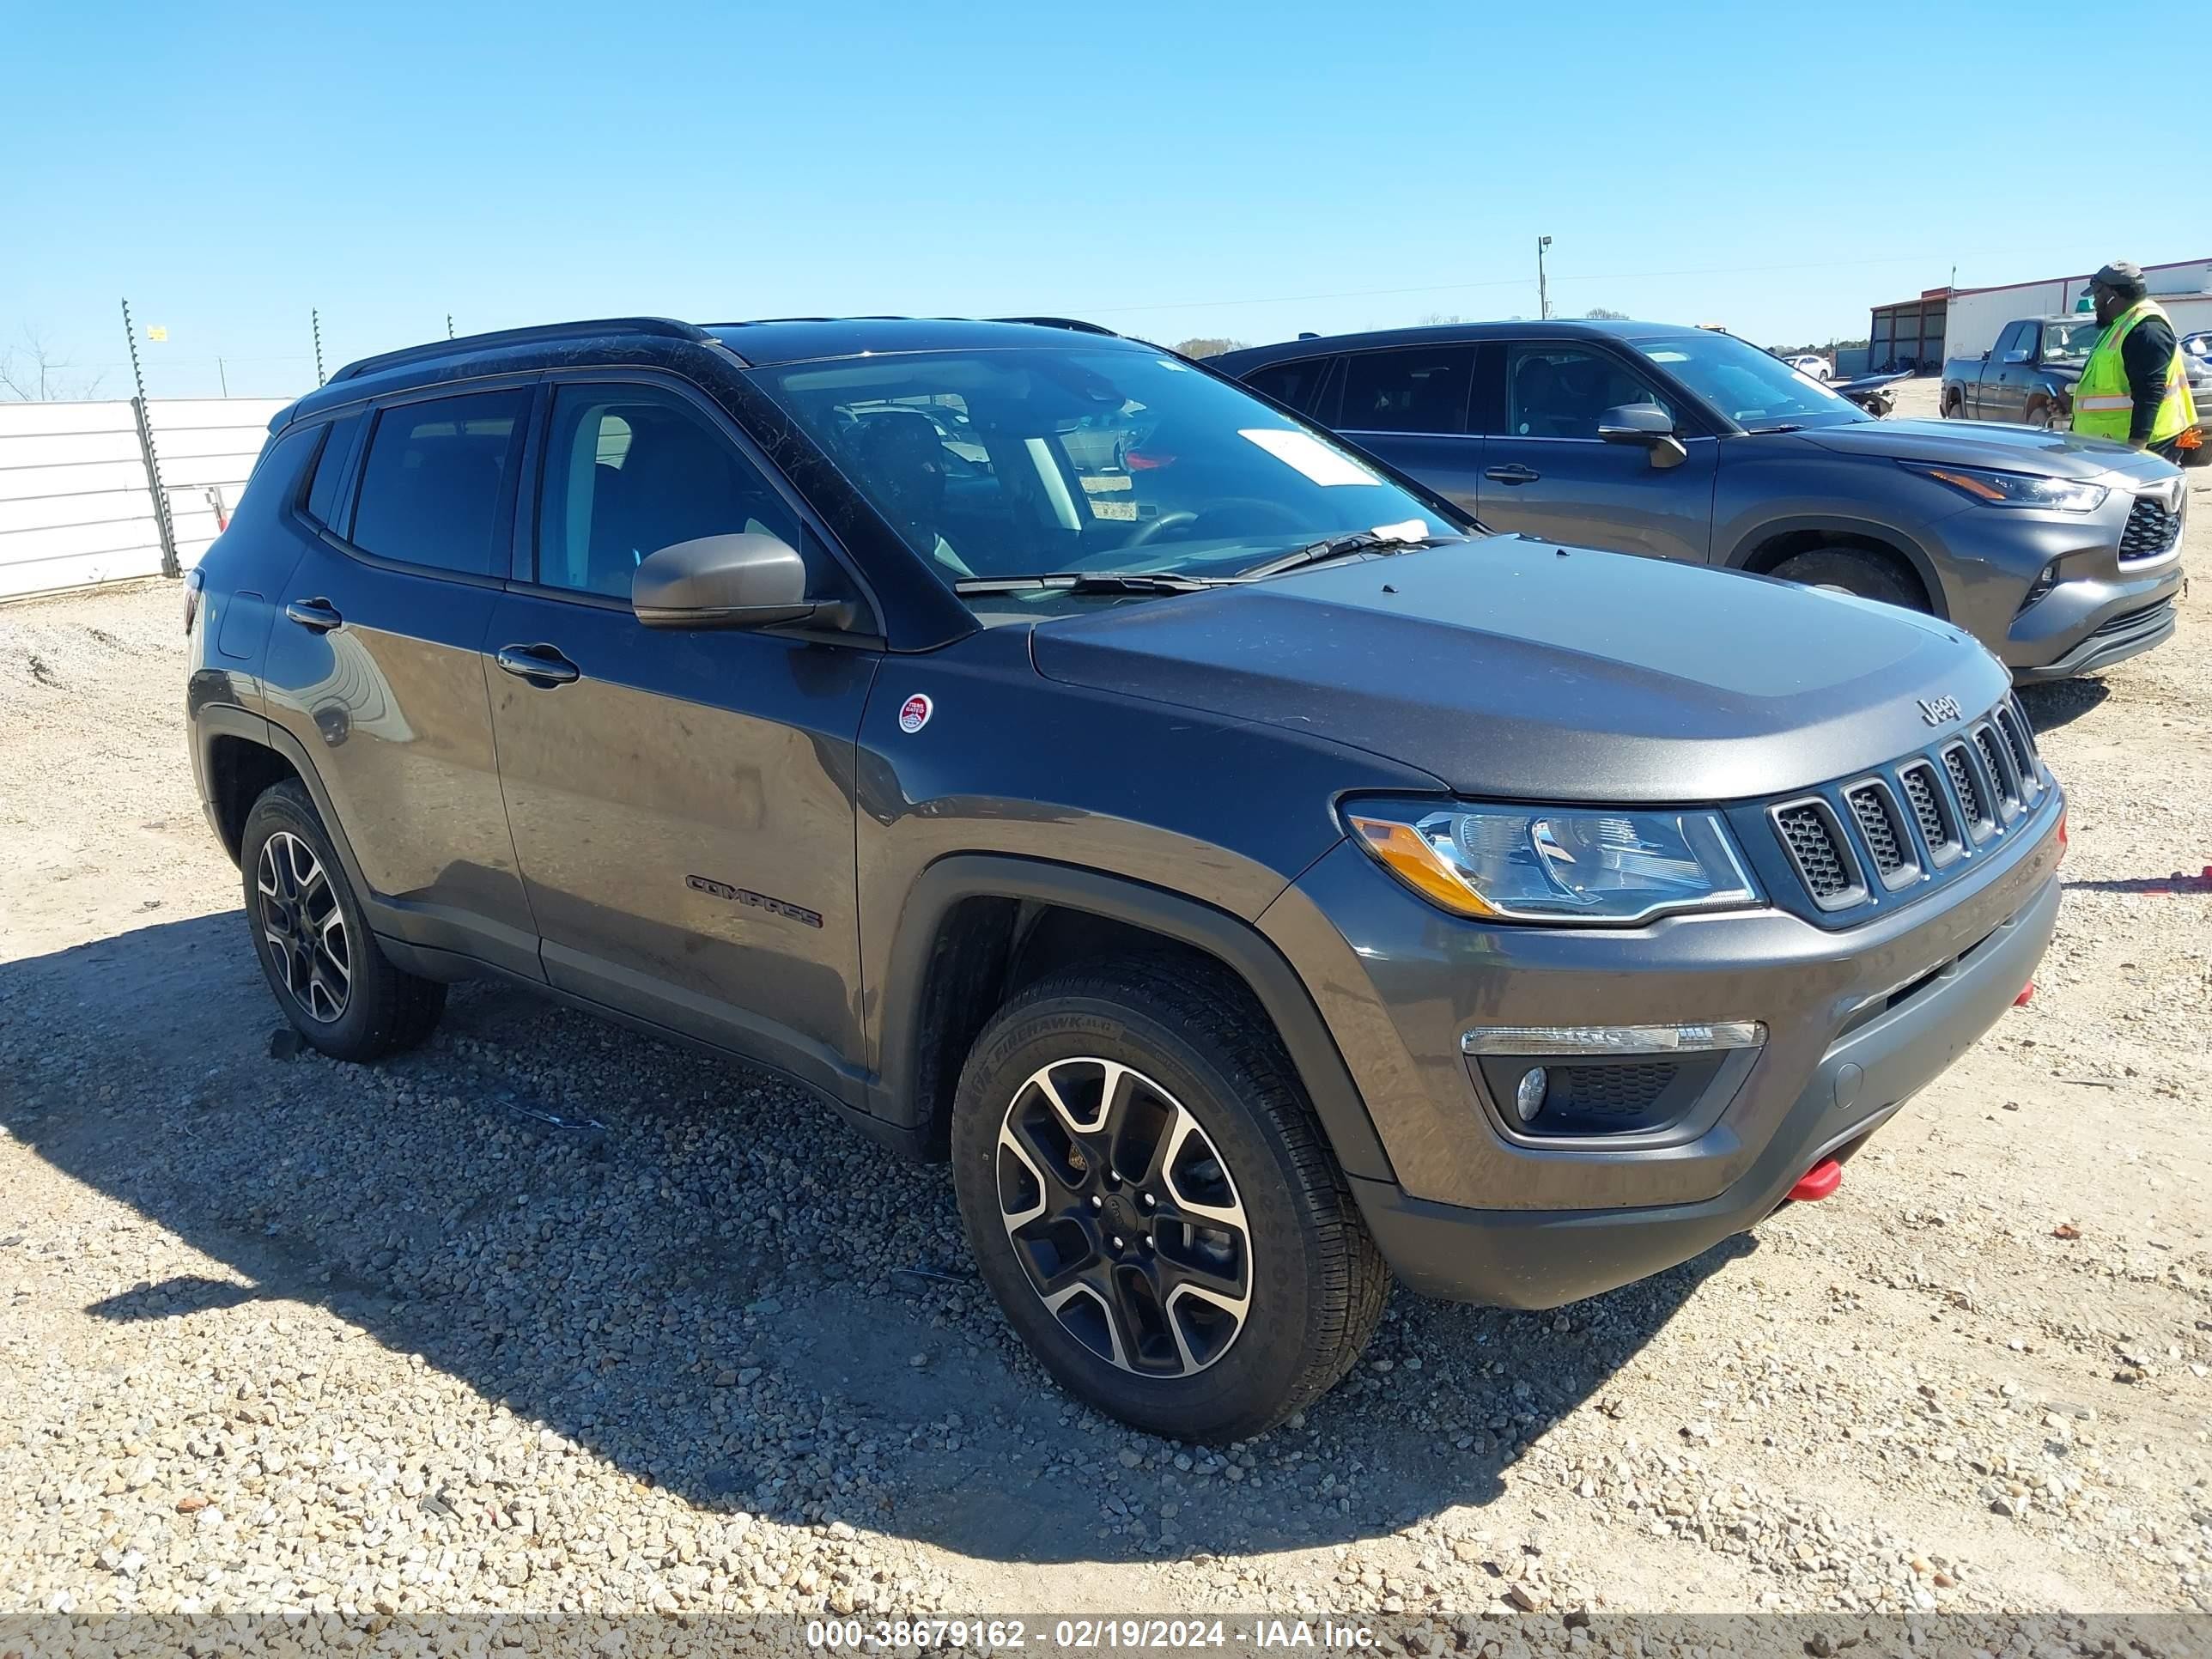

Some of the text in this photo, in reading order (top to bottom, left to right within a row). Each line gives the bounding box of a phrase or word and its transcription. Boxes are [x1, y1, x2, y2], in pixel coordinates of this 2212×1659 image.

[1916, 695, 1962, 728] Jeep
[685, 874, 823, 928] COMPASS
[994, 1016, 1080, 1061] FIREHAWK
